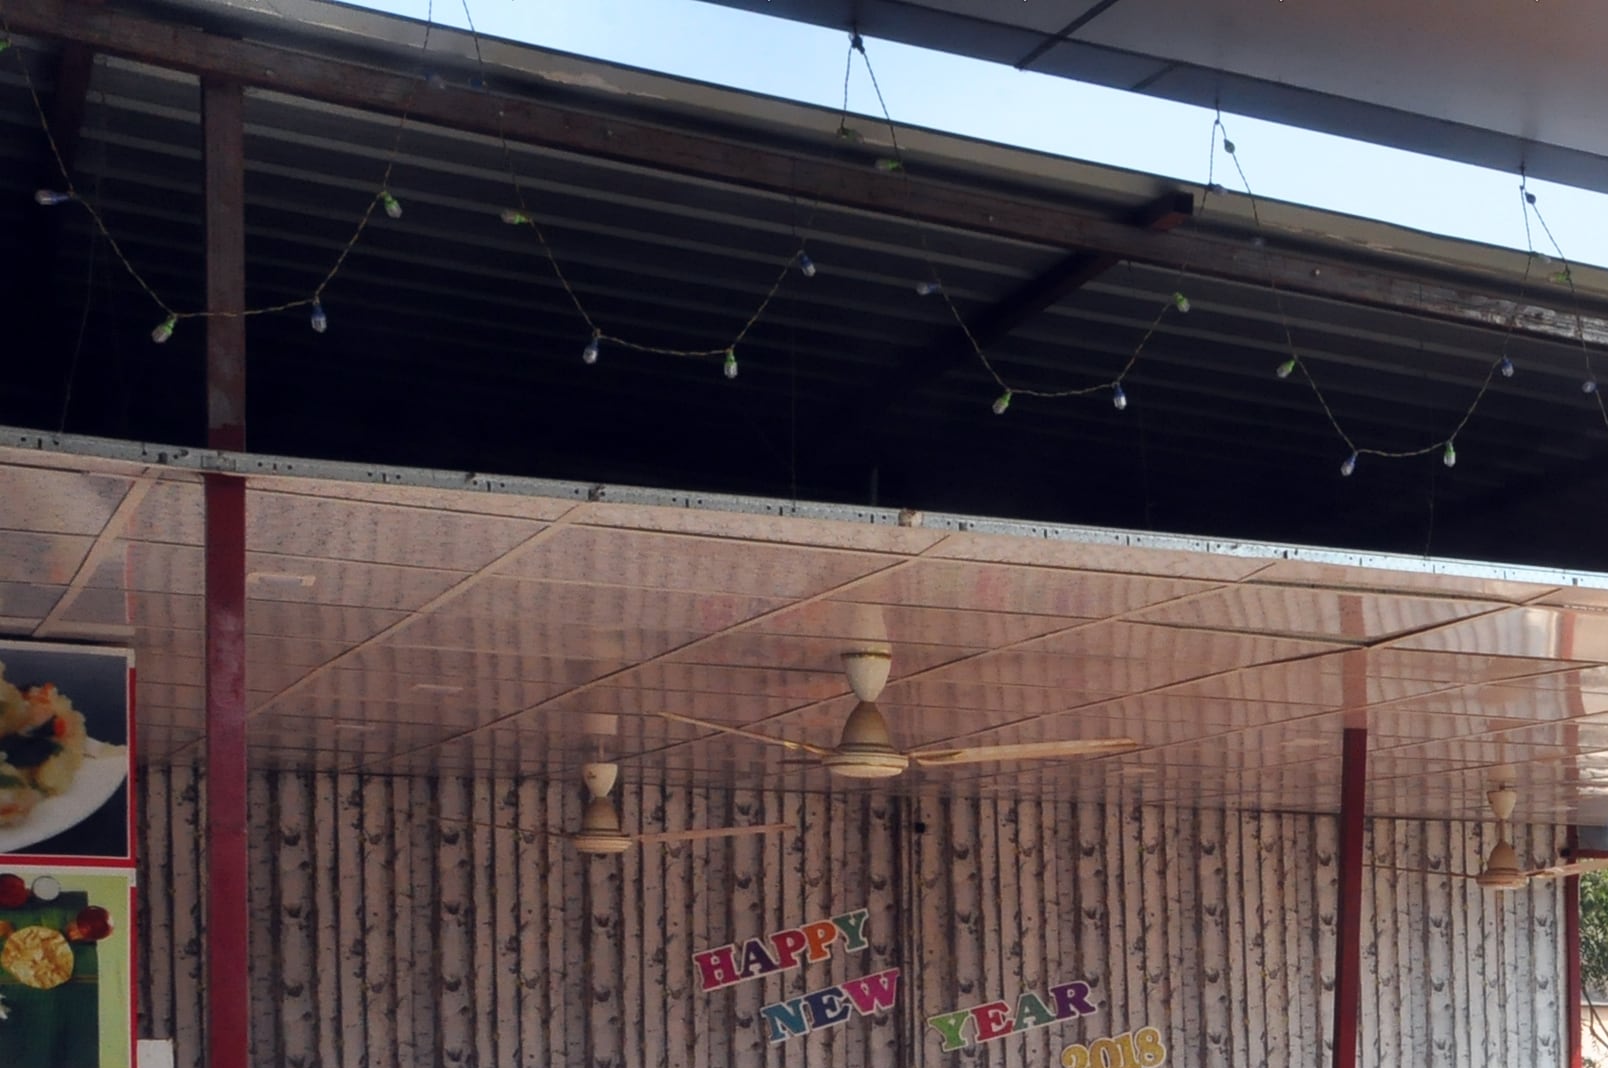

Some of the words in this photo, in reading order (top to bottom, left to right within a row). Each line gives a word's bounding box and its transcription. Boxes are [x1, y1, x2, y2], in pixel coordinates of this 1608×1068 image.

[693, 908, 870, 992] HAPPY
[760, 967, 900, 1043] NEW
[927, 980, 1096, 1051] YEAR
